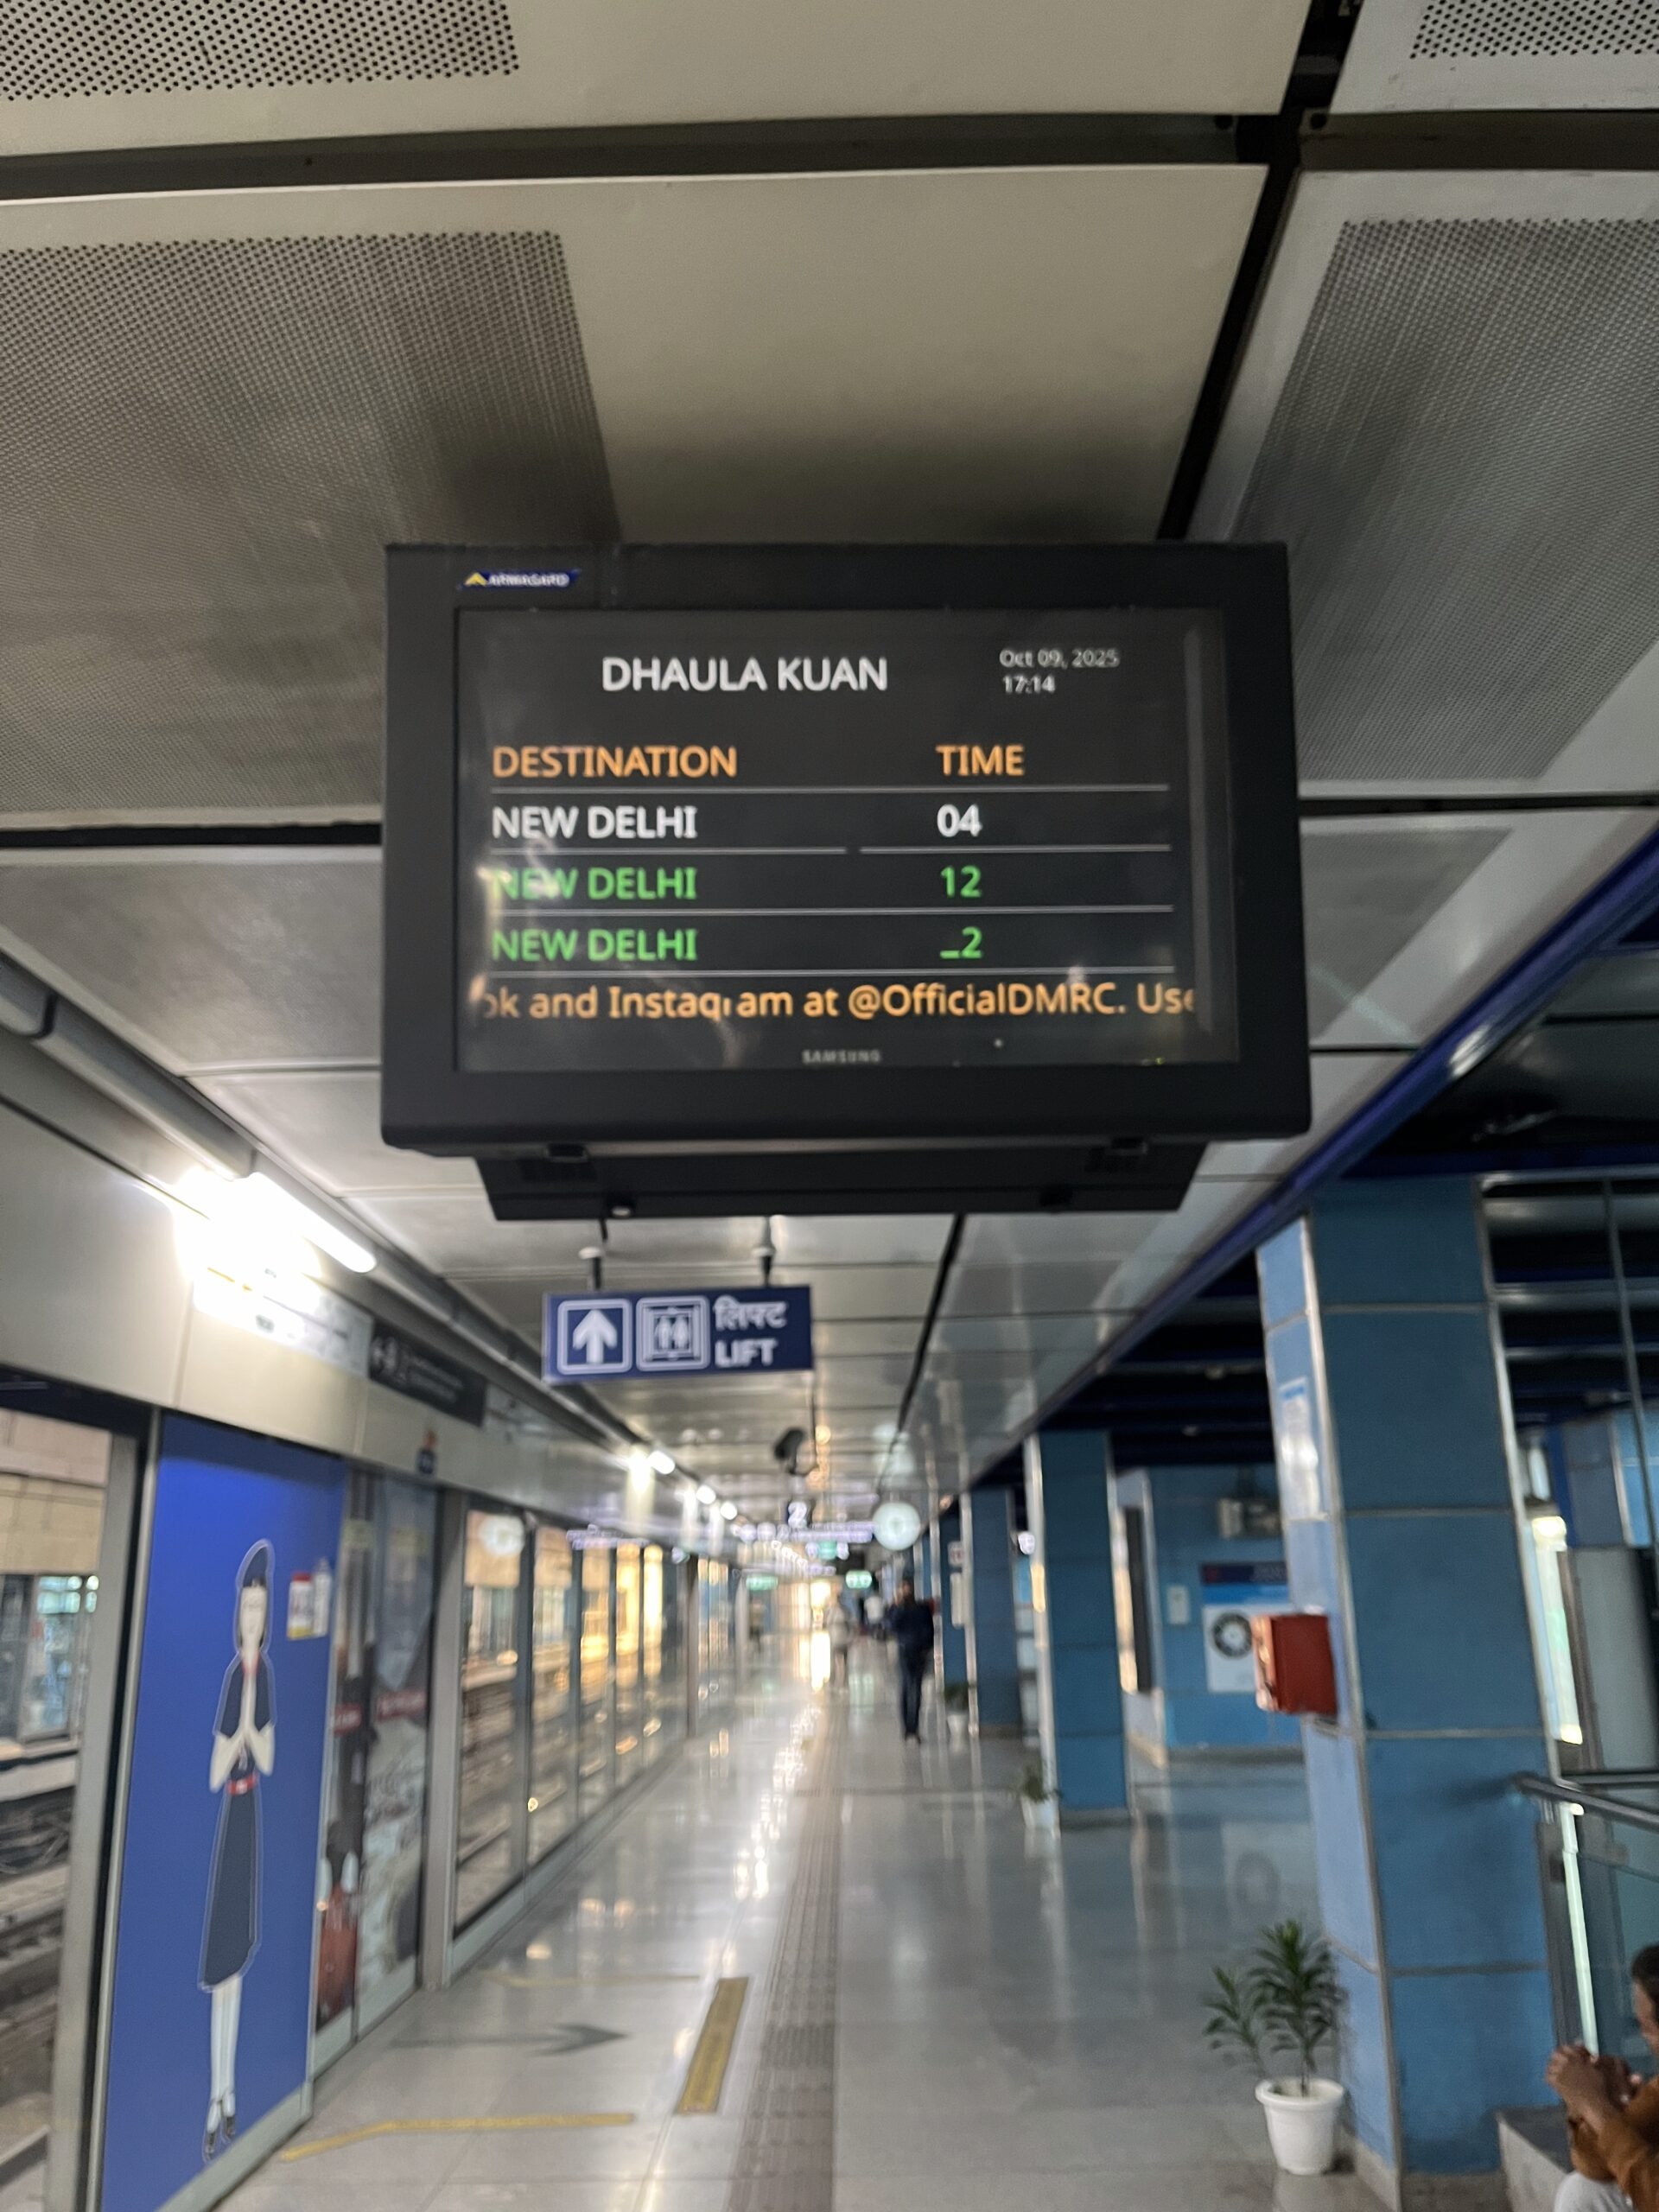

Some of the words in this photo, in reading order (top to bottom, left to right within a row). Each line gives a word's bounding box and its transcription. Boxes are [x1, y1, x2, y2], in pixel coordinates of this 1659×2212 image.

[602, 657, 768, 691] DHAULA
[778, 657, 887, 691] KUAN
[999, 649, 1033, 668] Oct
[1037, 649, 1068, 670] 09,
[1071, 649, 1120, 668] 2025
[1003, 674, 1056, 693] 17:14
[493, 746, 737, 778] DESTINATION
[936, 745, 1024, 776] TIME
[492, 805, 579, 839] NEW
[588, 805, 697, 839] DELHI
[937, 804, 982, 837] 04
[491, 867, 580, 900] NEW
[588, 867, 696, 899] DELHI
[941, 865, 981, 898] 12
[492, 928, 580, 962] NEW
[587, 928, 696, 962] DELHI
[529, 985, 598, 1019] and
[803, 988, 839, 1017] at
[848, 982, 1126, 1020] @OfficialDMRC.
[715, 1338, 779, 1368] LIFT
